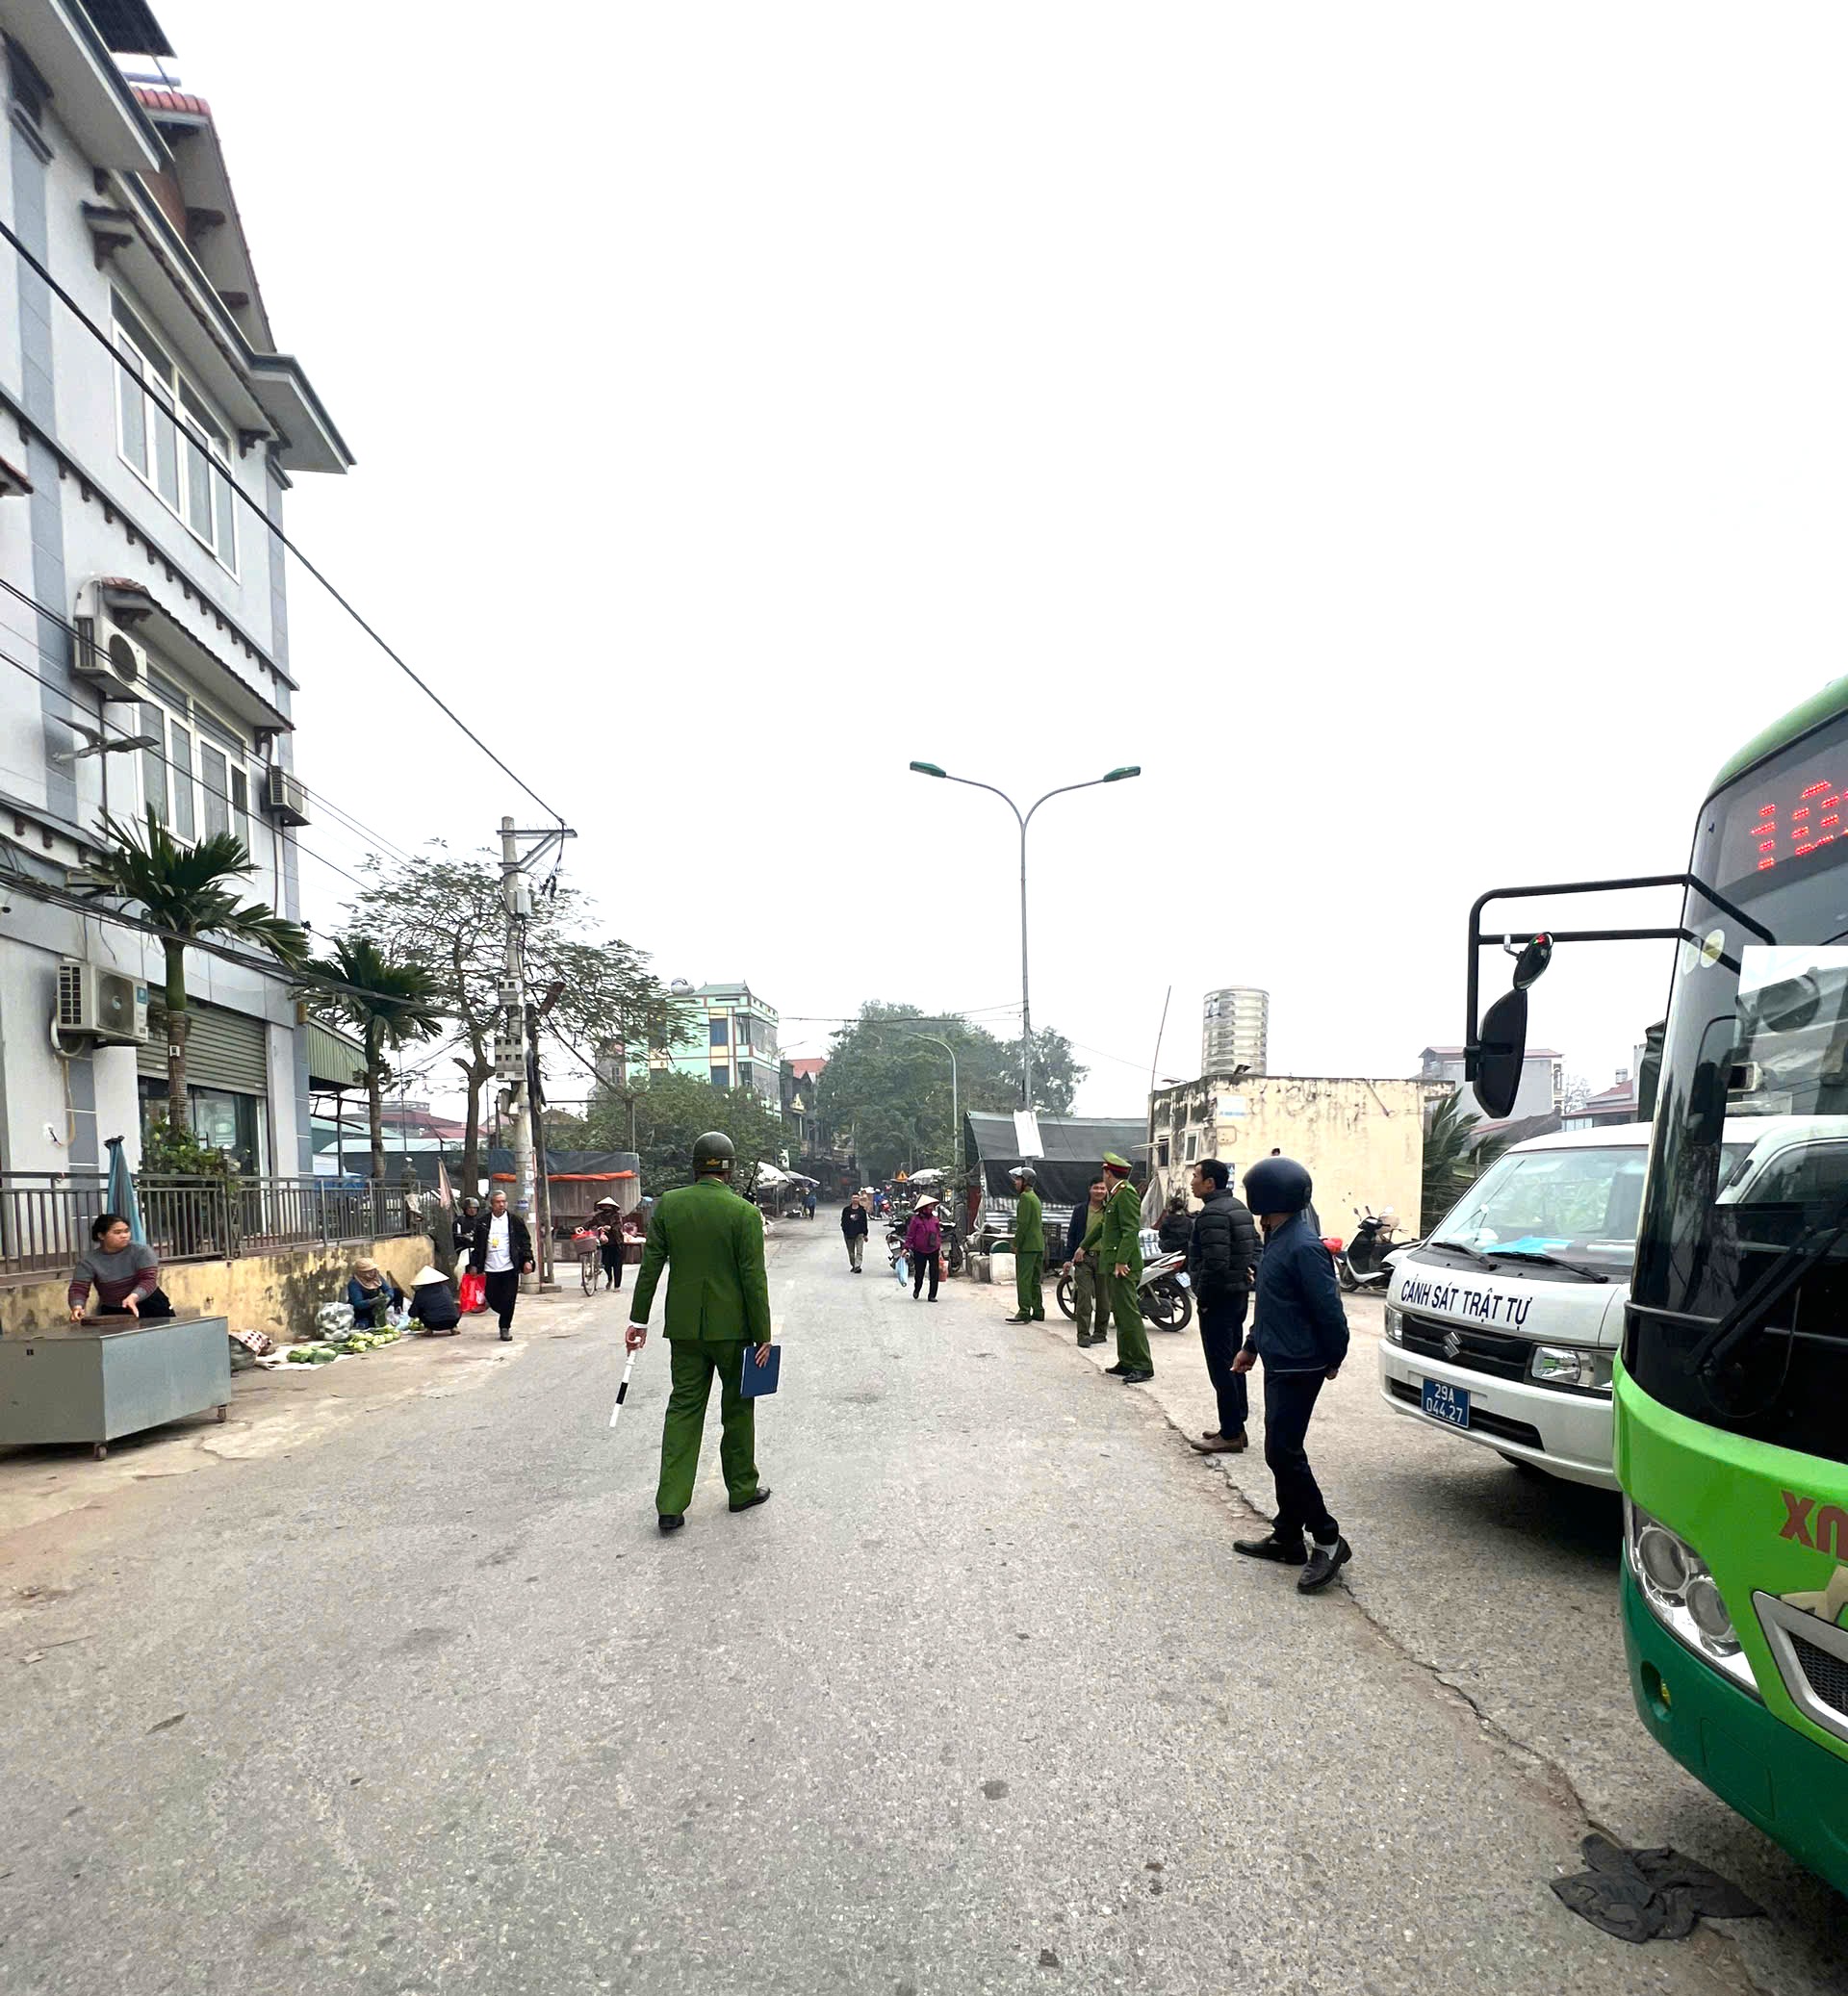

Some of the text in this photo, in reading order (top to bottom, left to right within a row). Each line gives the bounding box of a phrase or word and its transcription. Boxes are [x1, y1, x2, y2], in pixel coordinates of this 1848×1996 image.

[1432, 1282, 1459, 1311] SÁT
[1463, 1288, 1502, 1322] TRẬT
[1506, 1297, 1533, 1331] TỰ
[1434, 1384, 1454, 1403] 29A
[1426, 1397, 1463, 1422] 044.27
